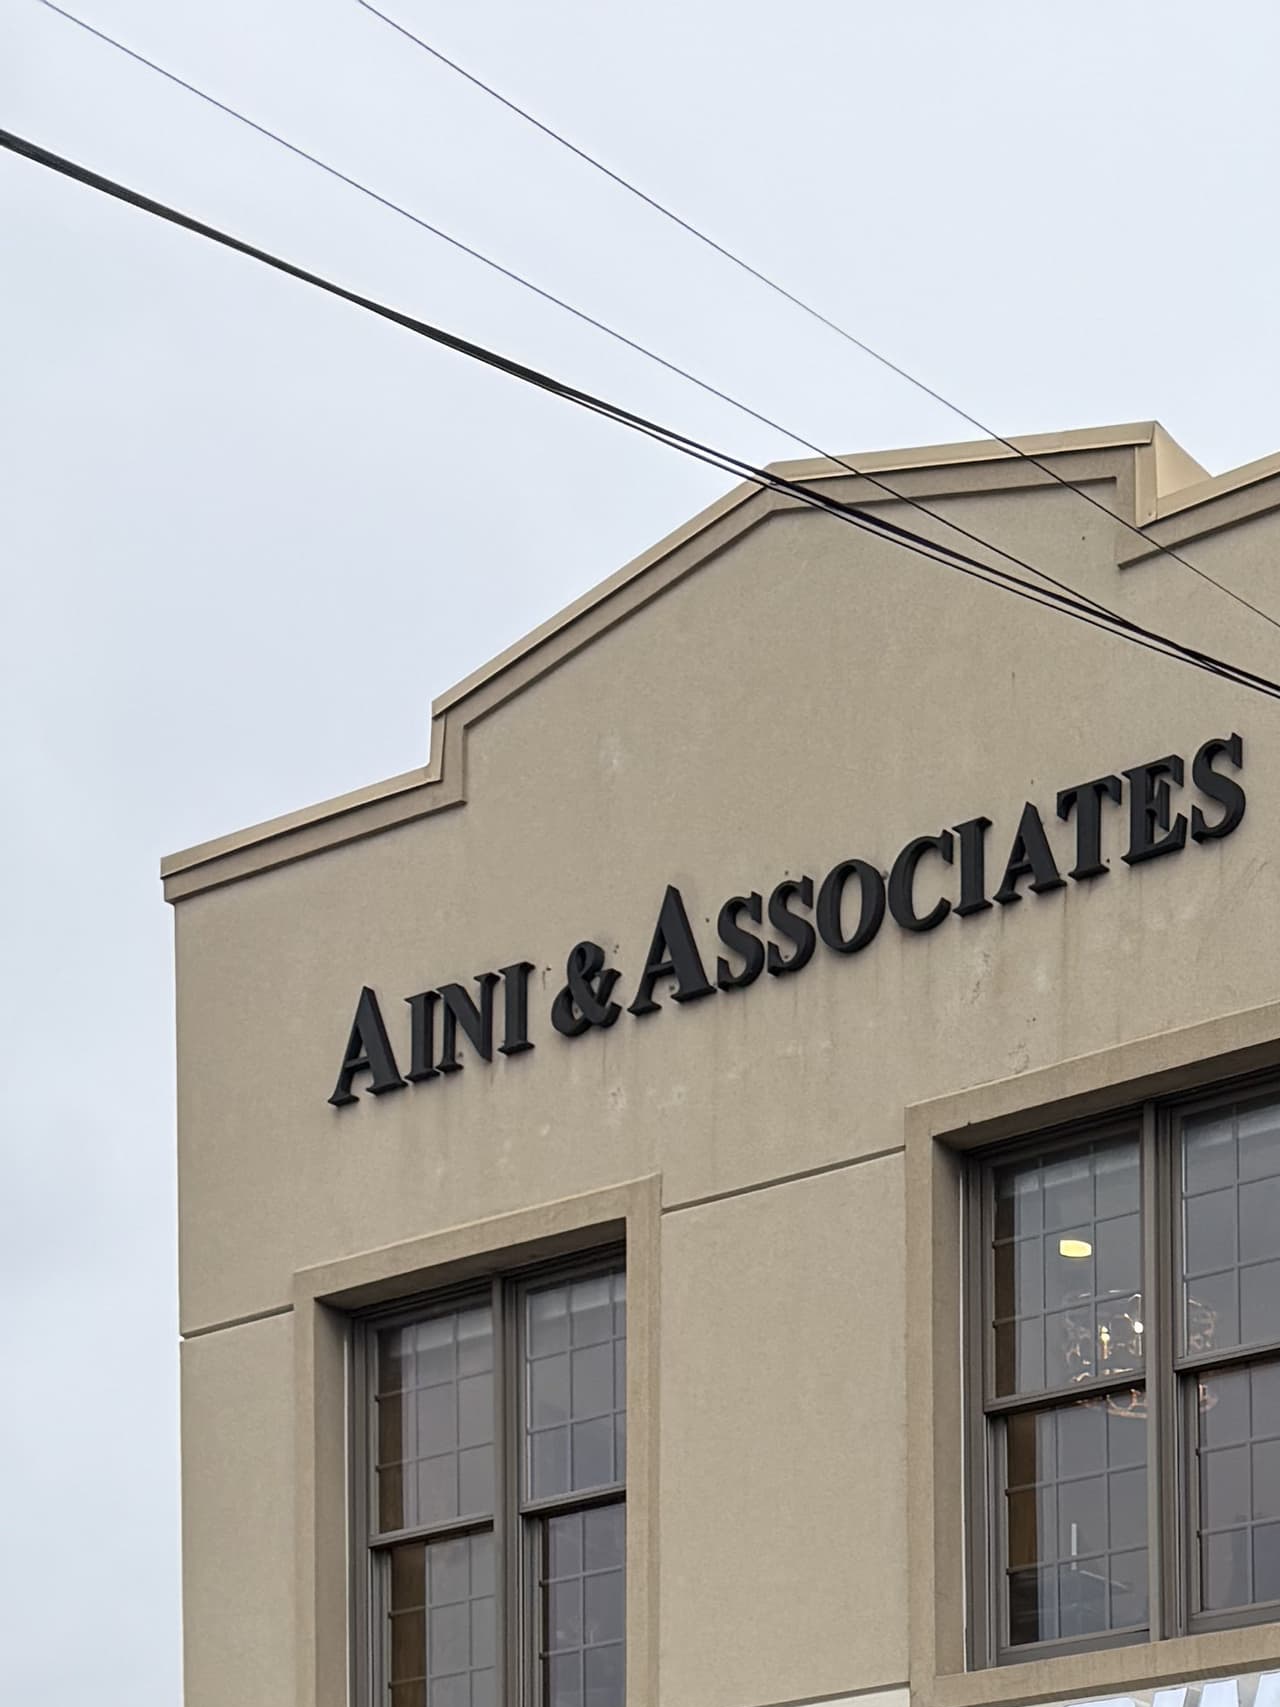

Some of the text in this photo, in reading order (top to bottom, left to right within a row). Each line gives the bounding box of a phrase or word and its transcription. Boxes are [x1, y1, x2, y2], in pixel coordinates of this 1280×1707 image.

[328, 732, 1246, 1106] AINI & ASSOCIATES
